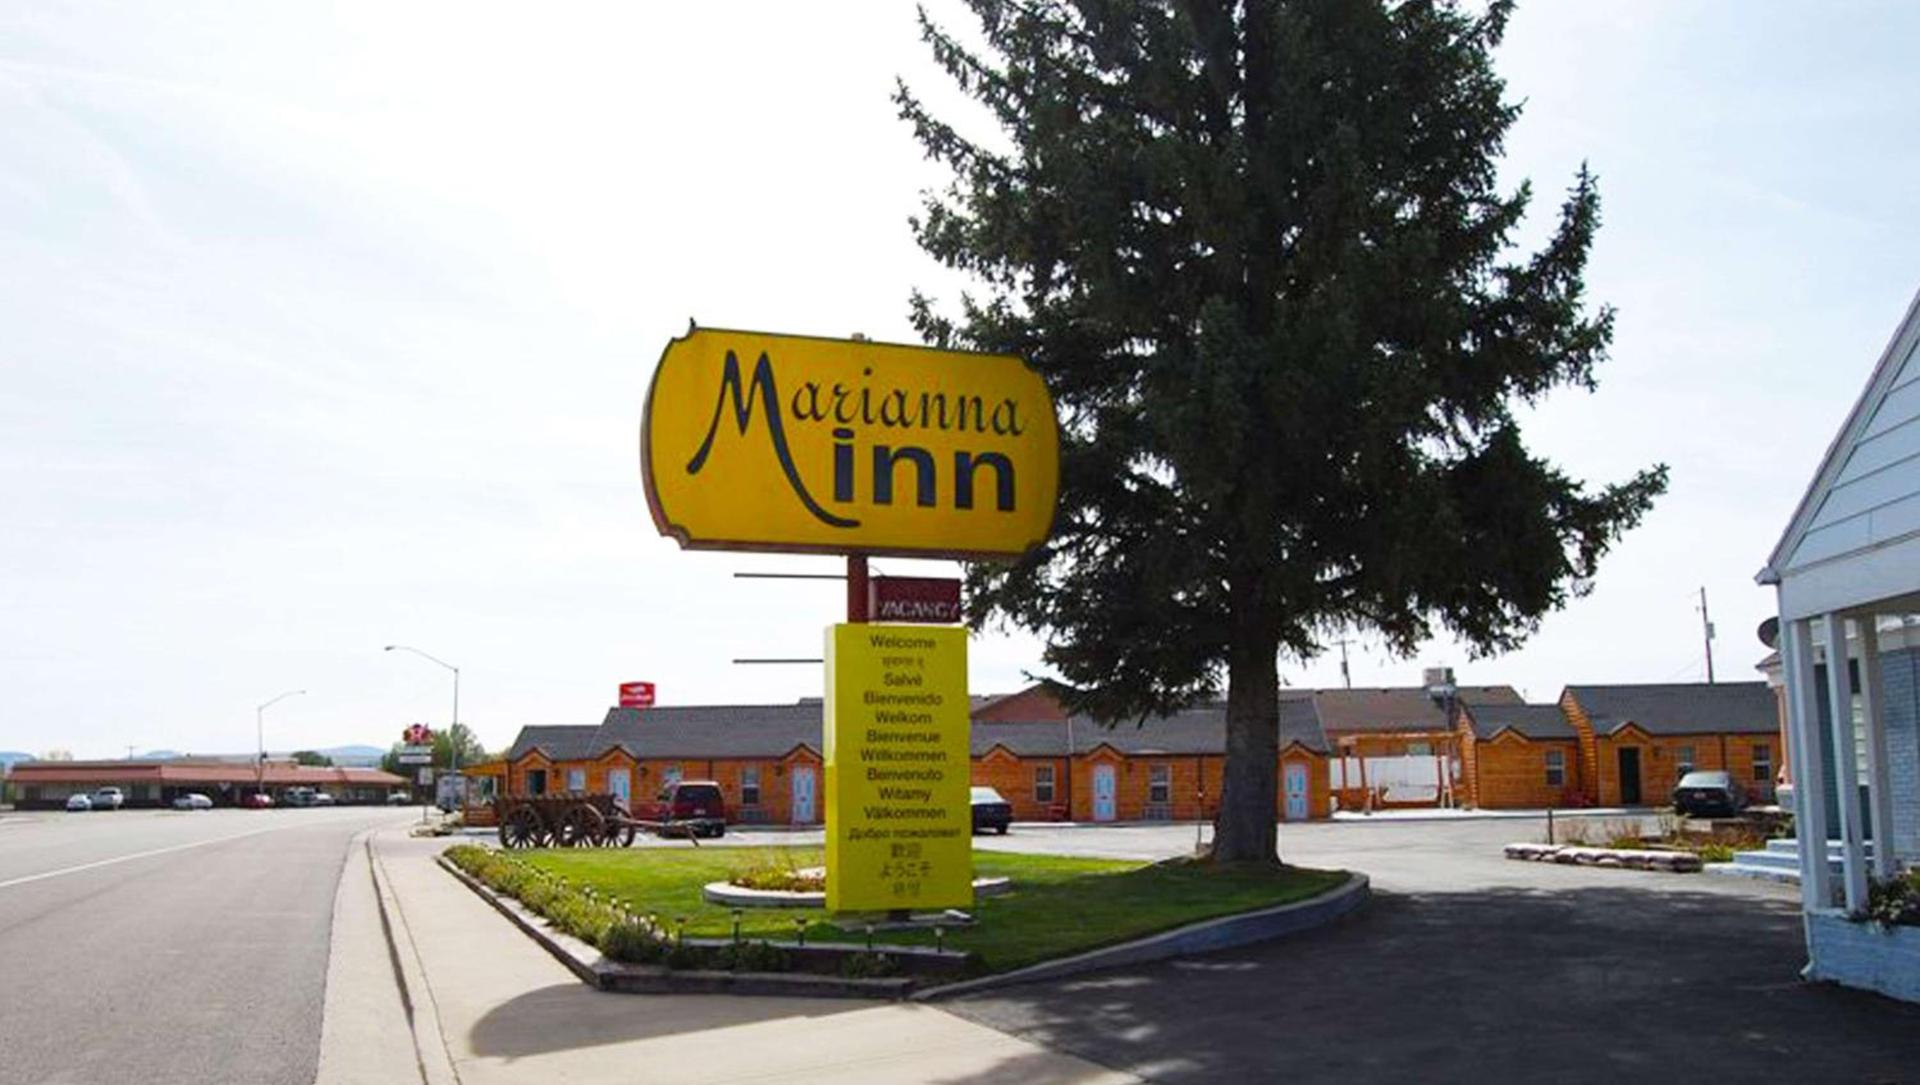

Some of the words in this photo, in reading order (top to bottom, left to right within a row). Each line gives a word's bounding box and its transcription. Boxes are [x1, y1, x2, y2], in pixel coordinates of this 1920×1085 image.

[687, 350, 1024, 528] Marianna
[832, 428, 1016, 511] inn
[879, 600, 959, 618] VACANCY
[870, 634, 936, 648] Welcome
[864, 691, 942, 705] Bienvenido
[875, 711, 932, 724] Welkom
[867, 730, 940, 743] Bienvenue
[861, 749, 947, 761] Willkommen
[867, 768, 943, 780] Benvenuto
[879, 787, 932, 802] Witamy
[864, 805, 946, 819] Välkommen
